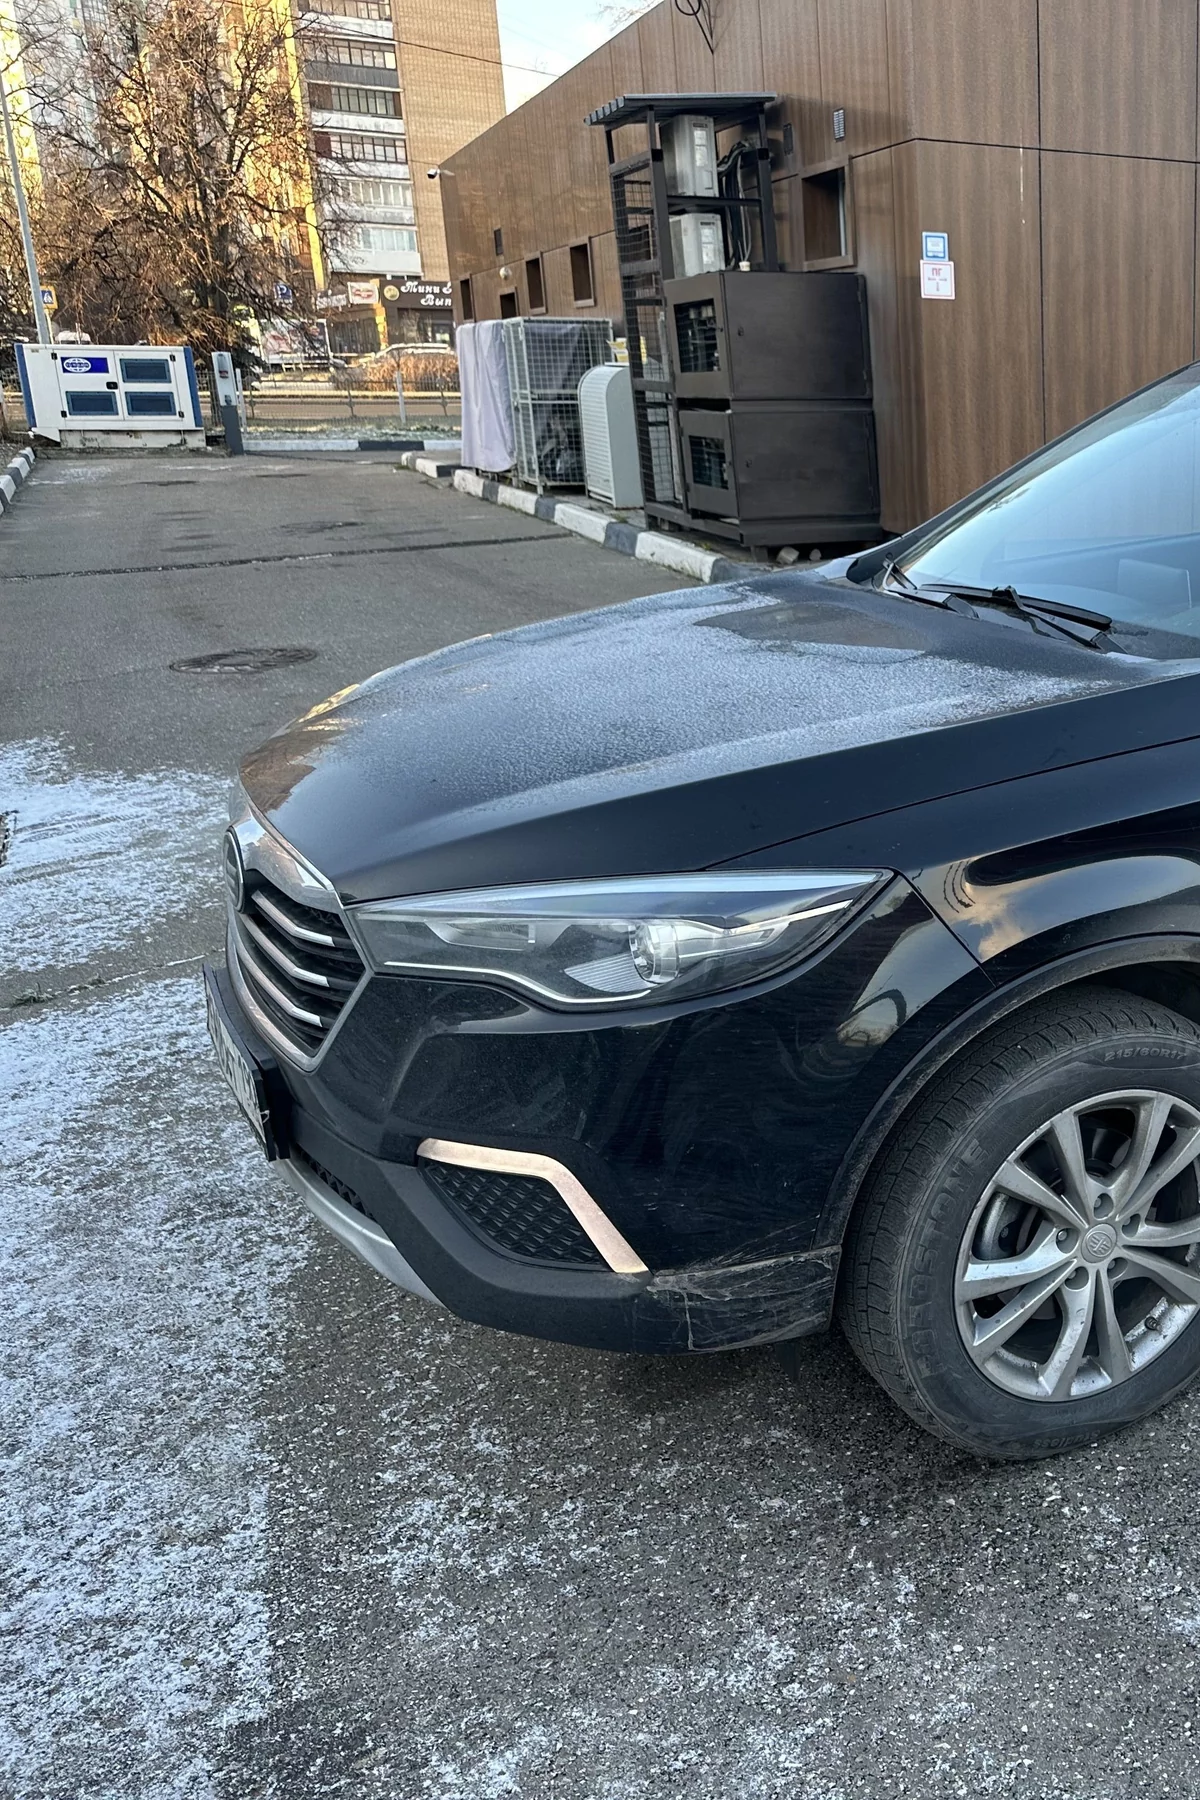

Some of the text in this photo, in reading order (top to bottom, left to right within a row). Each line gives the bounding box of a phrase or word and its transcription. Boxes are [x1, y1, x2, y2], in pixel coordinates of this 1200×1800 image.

[931, 267, 943, 276] ПГ
[400, 281, 440, 293] Мини
[1104, 1047, 1187, 1062] 215/60R17
